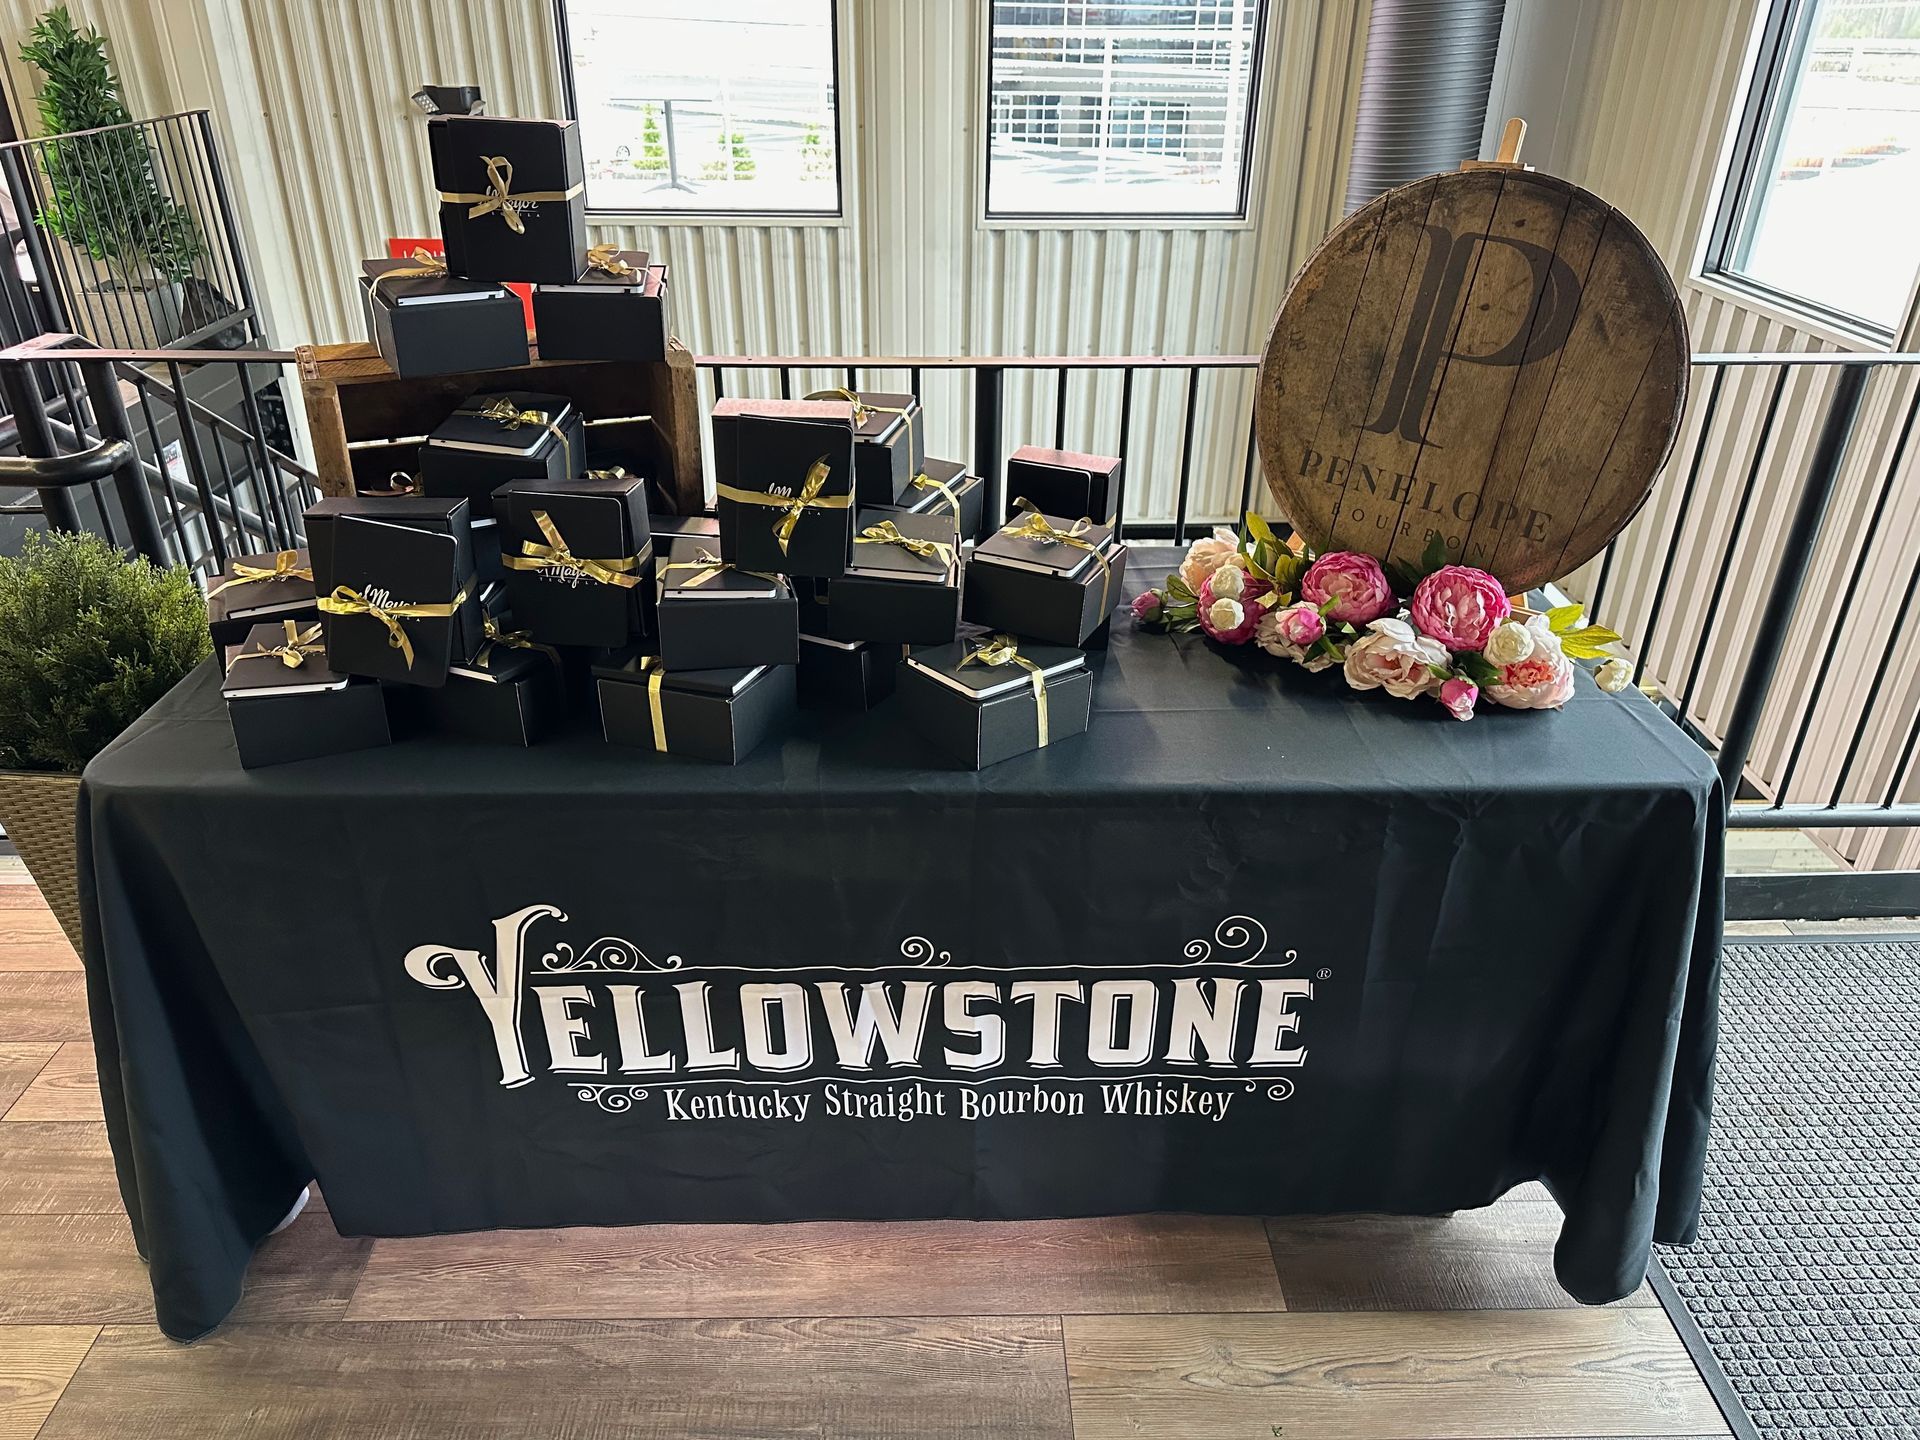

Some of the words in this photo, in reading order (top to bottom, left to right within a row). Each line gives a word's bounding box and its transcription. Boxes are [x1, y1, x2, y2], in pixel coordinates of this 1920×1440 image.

[1298, 445, 1553, 543] PENELOPE
[1330, 502, 1488, 559] BOURBON
[404, 904, 1314, 1089] YELLOWSTONE
[663, 1088, 812, 1122] Kentucky
[824, 1083, 946, 1122] Straight
[959, 1084, 1085, 1121] Bourbon
[1099, 1082, 1235, 1122] Whiskey
